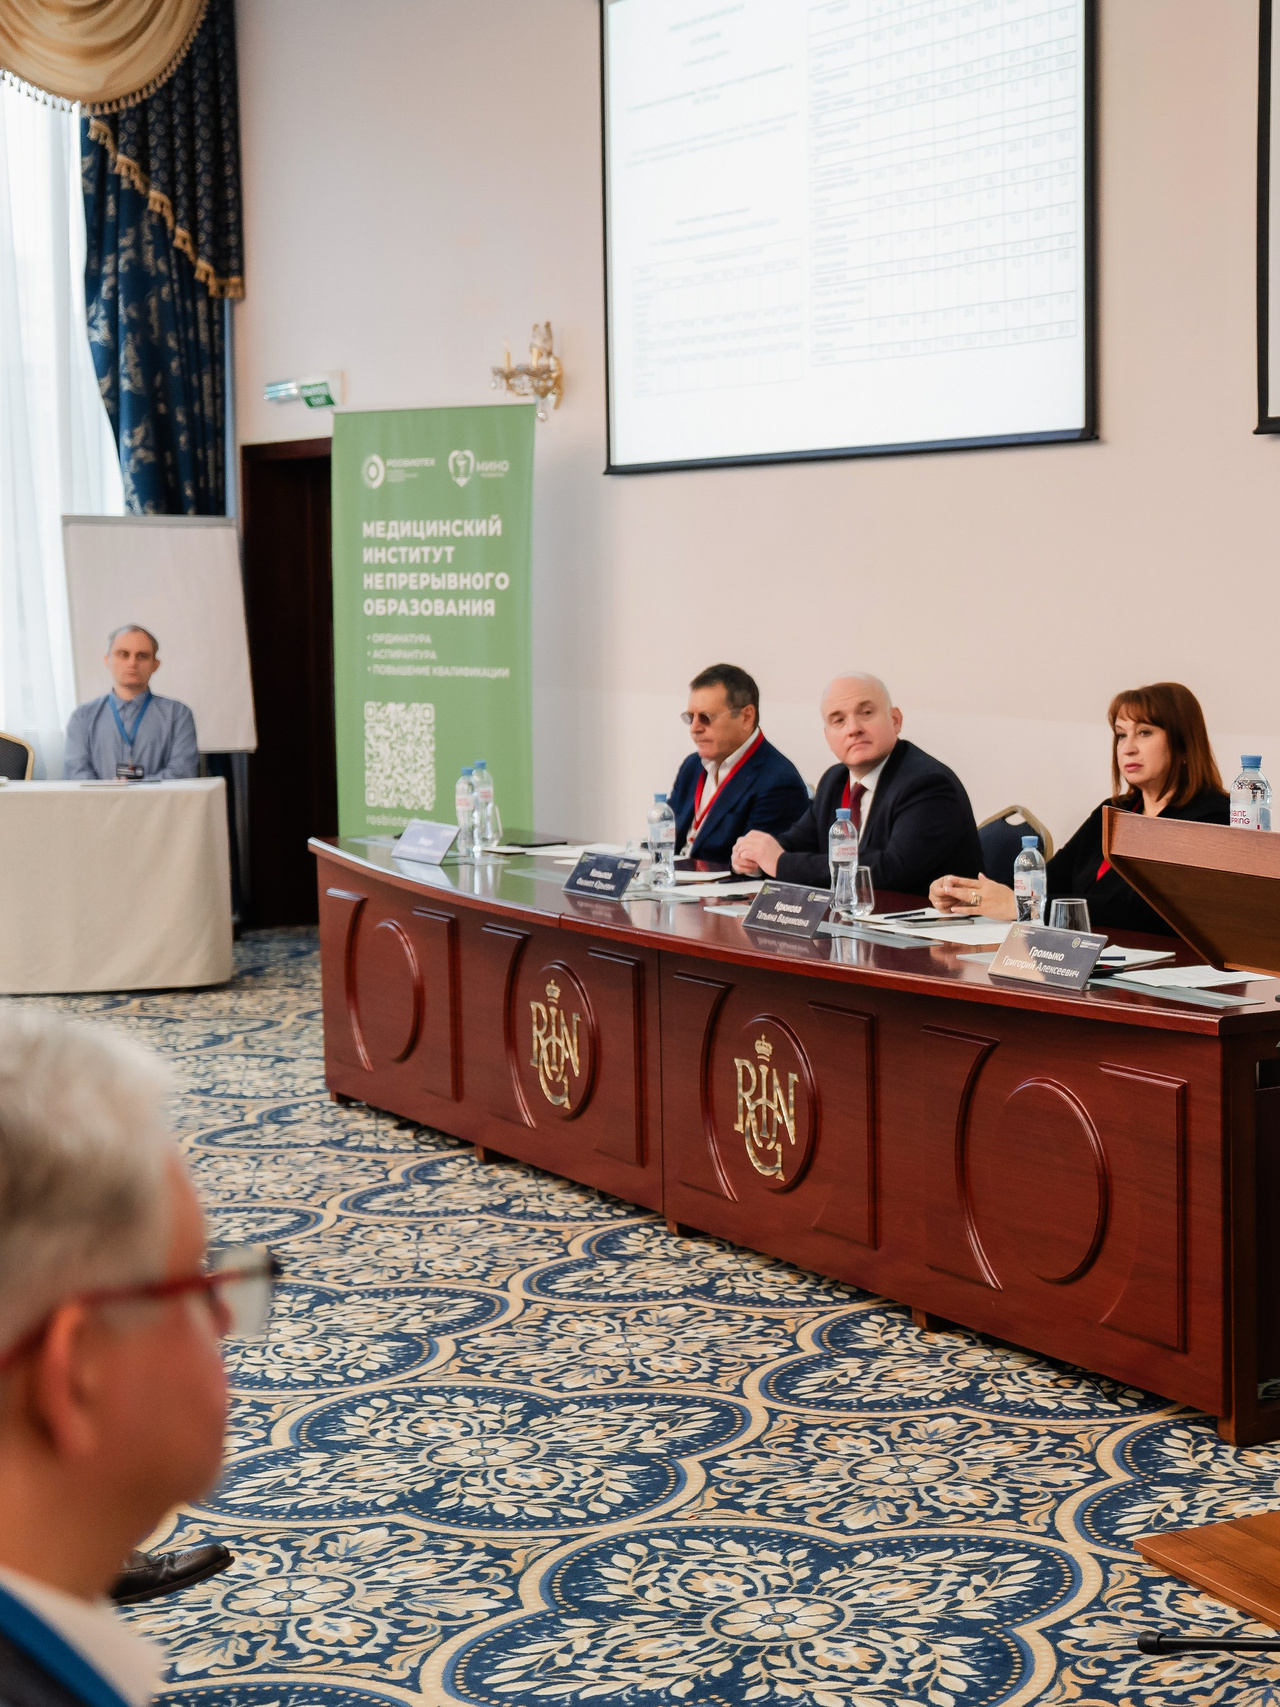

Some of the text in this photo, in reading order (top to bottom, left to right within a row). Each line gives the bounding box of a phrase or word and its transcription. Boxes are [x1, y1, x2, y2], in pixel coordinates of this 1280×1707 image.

[476, 460, 510, 473] МИНО
[362, 514, 502, 541] МЕДИЦИНСКИЙ
[362, 546, 455, 565] ИНСТИТУТ
[362, 572, 510, 591] НЕПРЕРЫВНОГО
[363, 598, 496, 617] ОБРАЗОВАНИЯ
[371, 633, 432, 645] ОРДИНАТУРА
[372, 649, 437, 660] АСПИРАНТУРА
[372, 665, 510, 679] ПОВЫШЕНИЕ КВАЛИФИКАЦИИ
[756, 910, 810, 928] Татьяна Вадимовна
[1028, 946, 1065, 962] Громыко
[1002, 955, 1080, 978] Григорий Алексеевич
